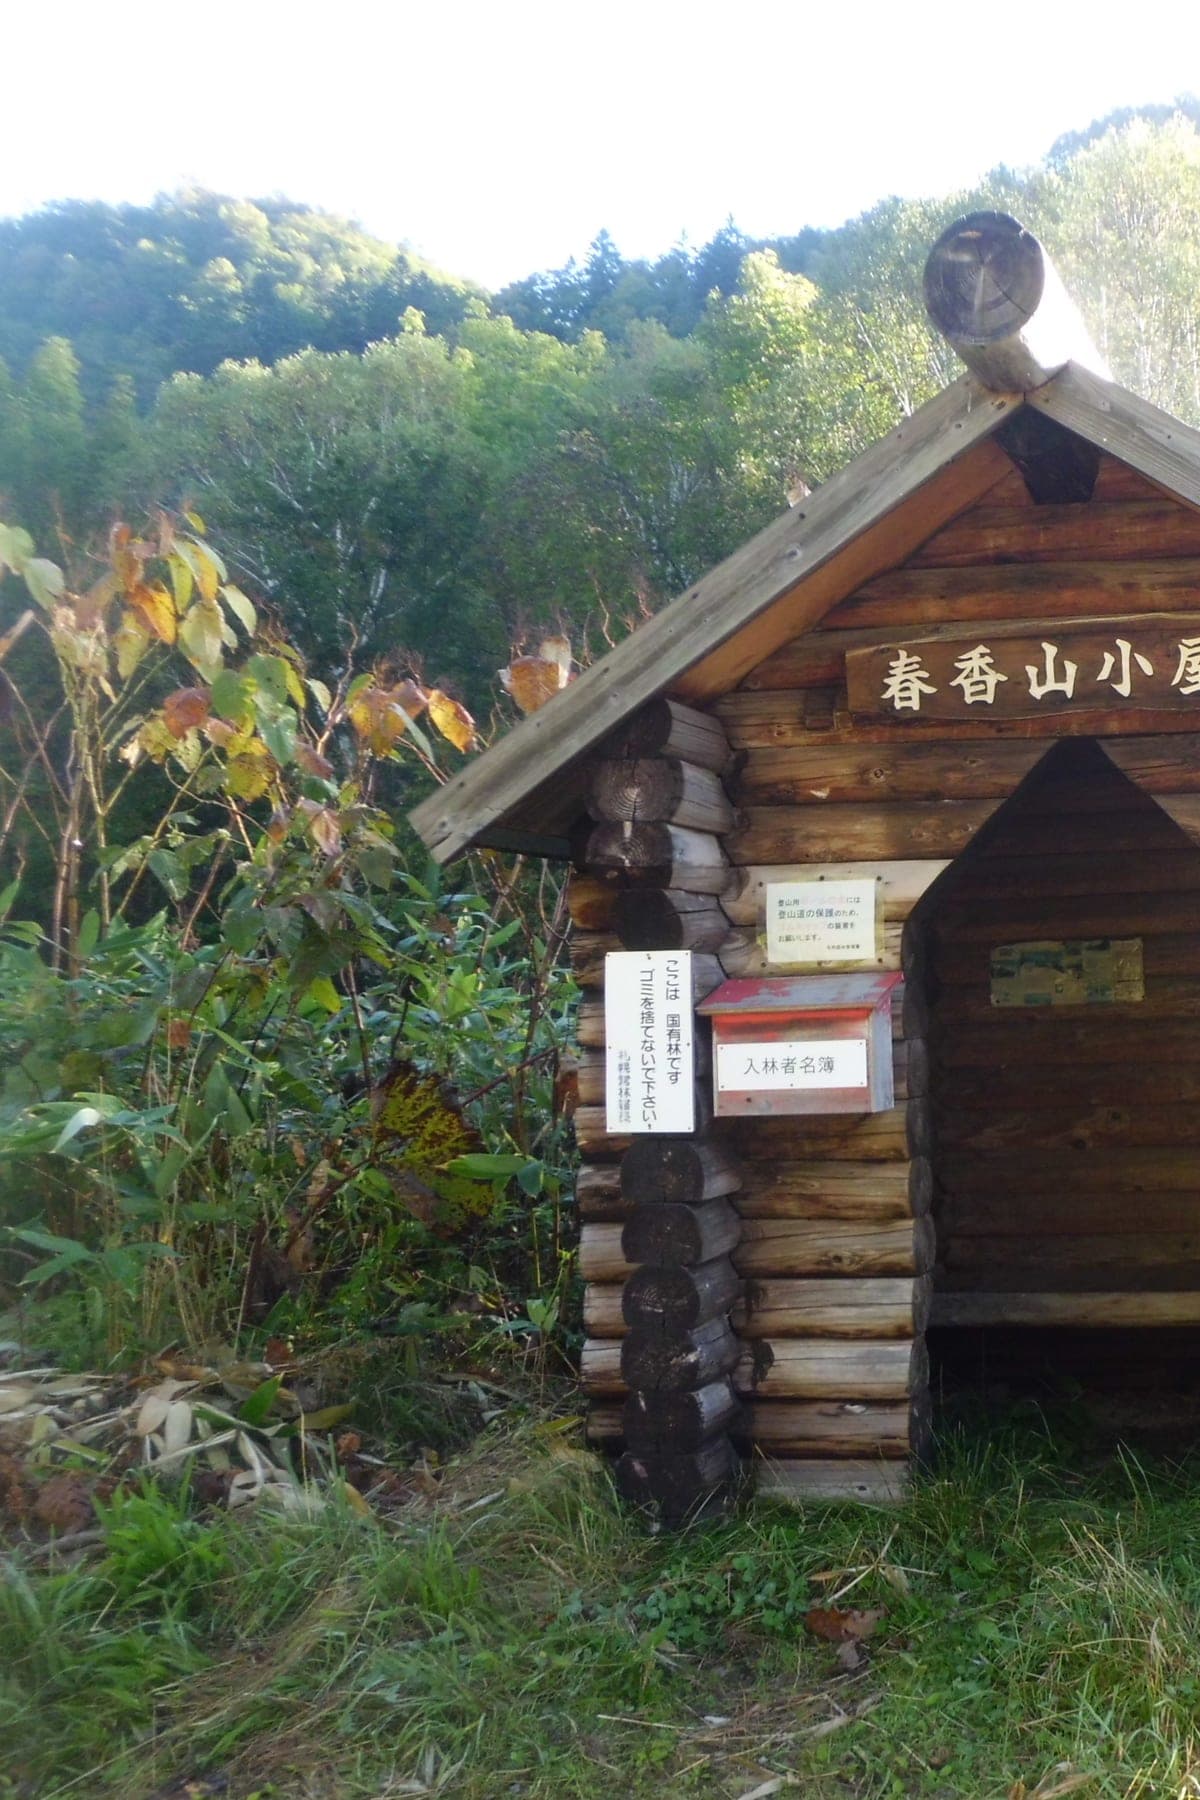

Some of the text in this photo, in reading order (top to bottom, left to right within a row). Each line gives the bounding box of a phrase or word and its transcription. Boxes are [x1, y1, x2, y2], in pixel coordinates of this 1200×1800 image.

[665, 959, 682, 1085] ここは 国有林です
[743, 1056, 836, 1075] 入林者名簿
